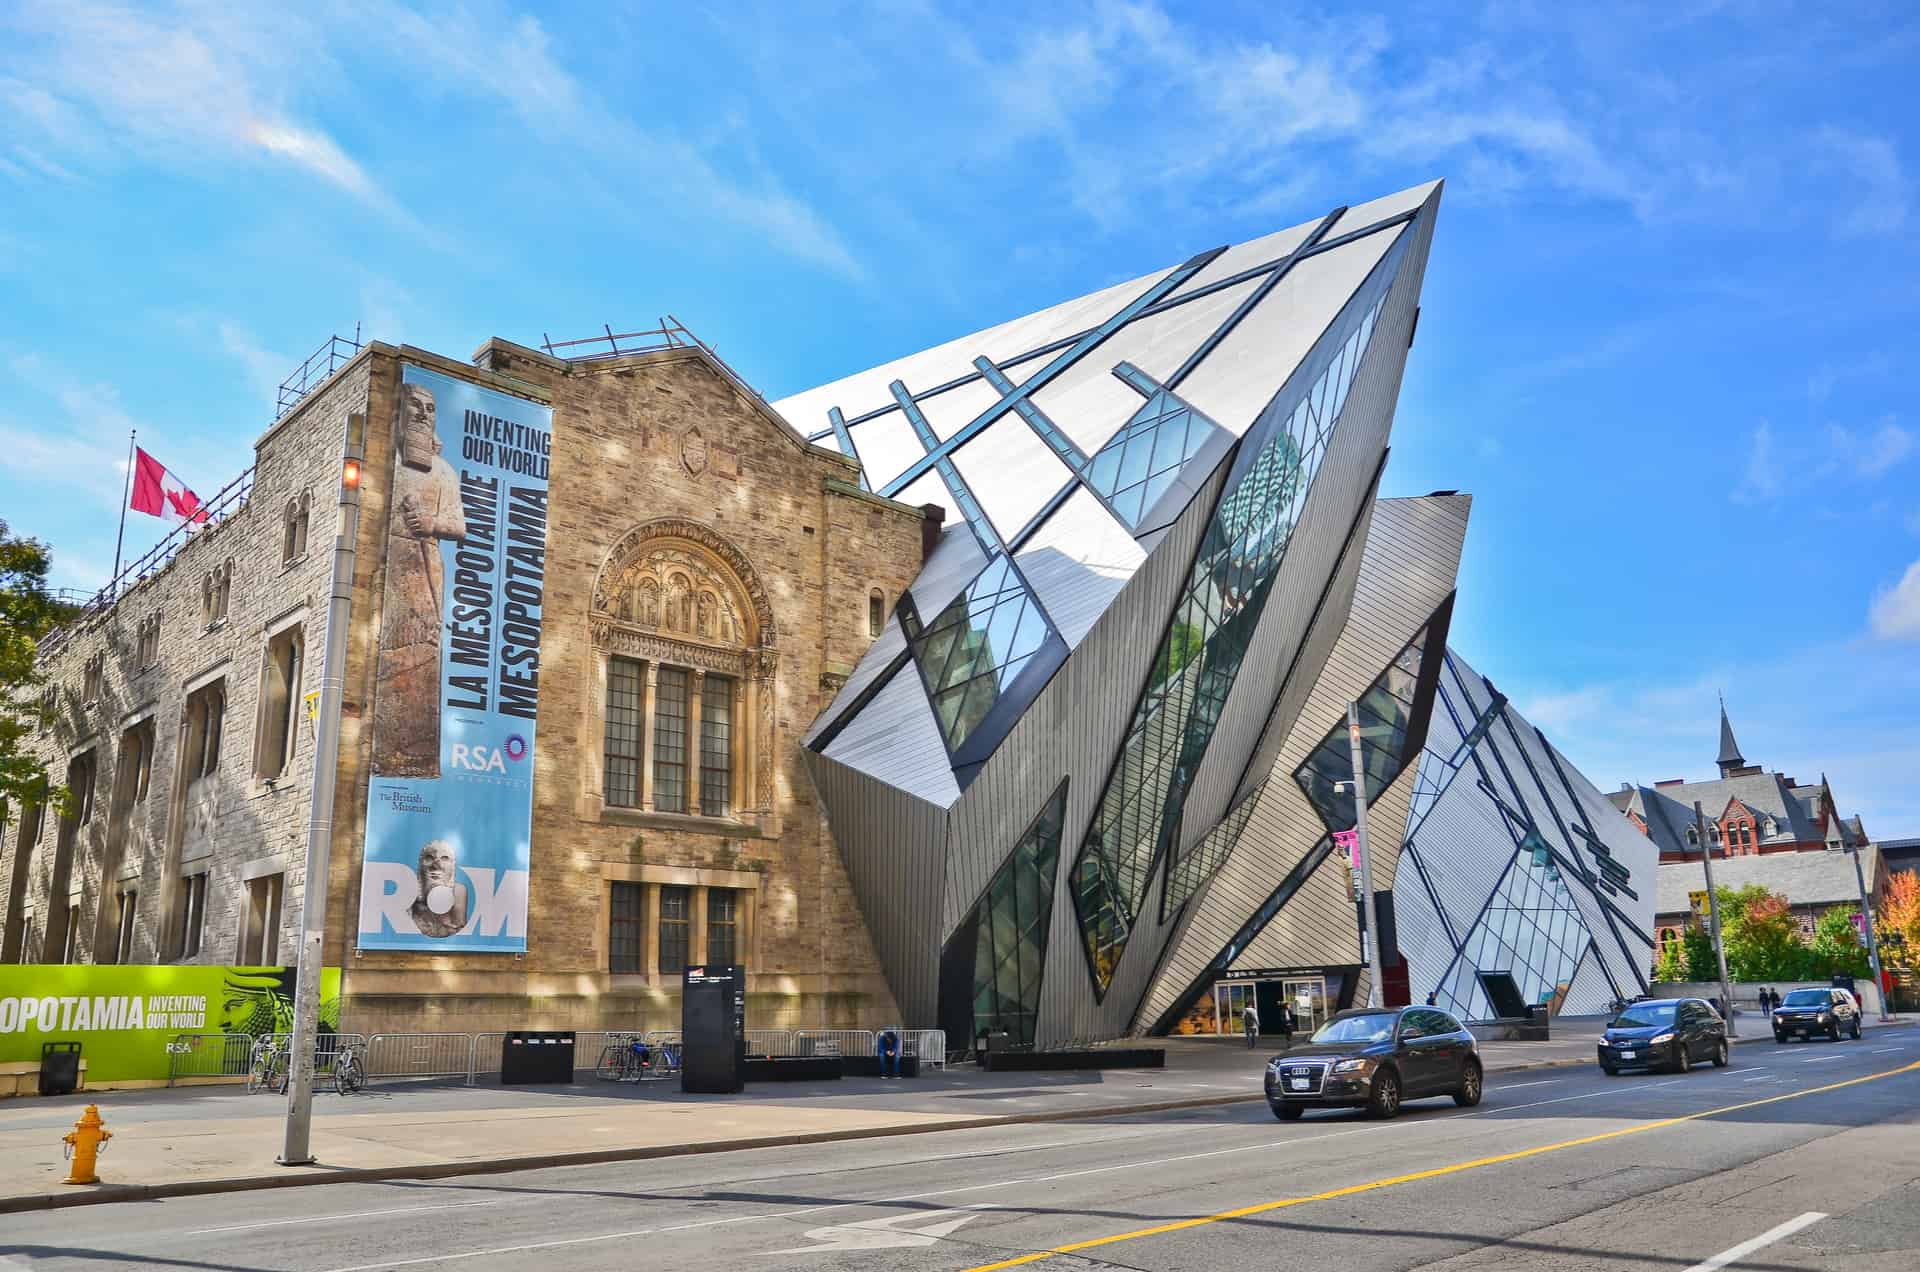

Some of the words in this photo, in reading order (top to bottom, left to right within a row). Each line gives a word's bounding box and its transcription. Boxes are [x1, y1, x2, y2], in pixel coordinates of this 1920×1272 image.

[464, 409, 552, 456] INVENTING
[463, 436, 494, 466] OUR
[498, 444, 550, 480] WORLD
[446, 469, 498, 668] MÉSOPOTAMIE
[498, 486, 548, 720] MESOPOTAMIA
[447, 676, 489, 711] LA
[451, 743, 507, 774] RSA
[0, 996, 144, 1033] OPOTAMIA
[146, 1013, 168, 1029] OUR
[171, 1013, 206, 1029] WORLD
[148, 995, 207, 1012] INVENTING
[166, 1042, 192, 1054] RSA
